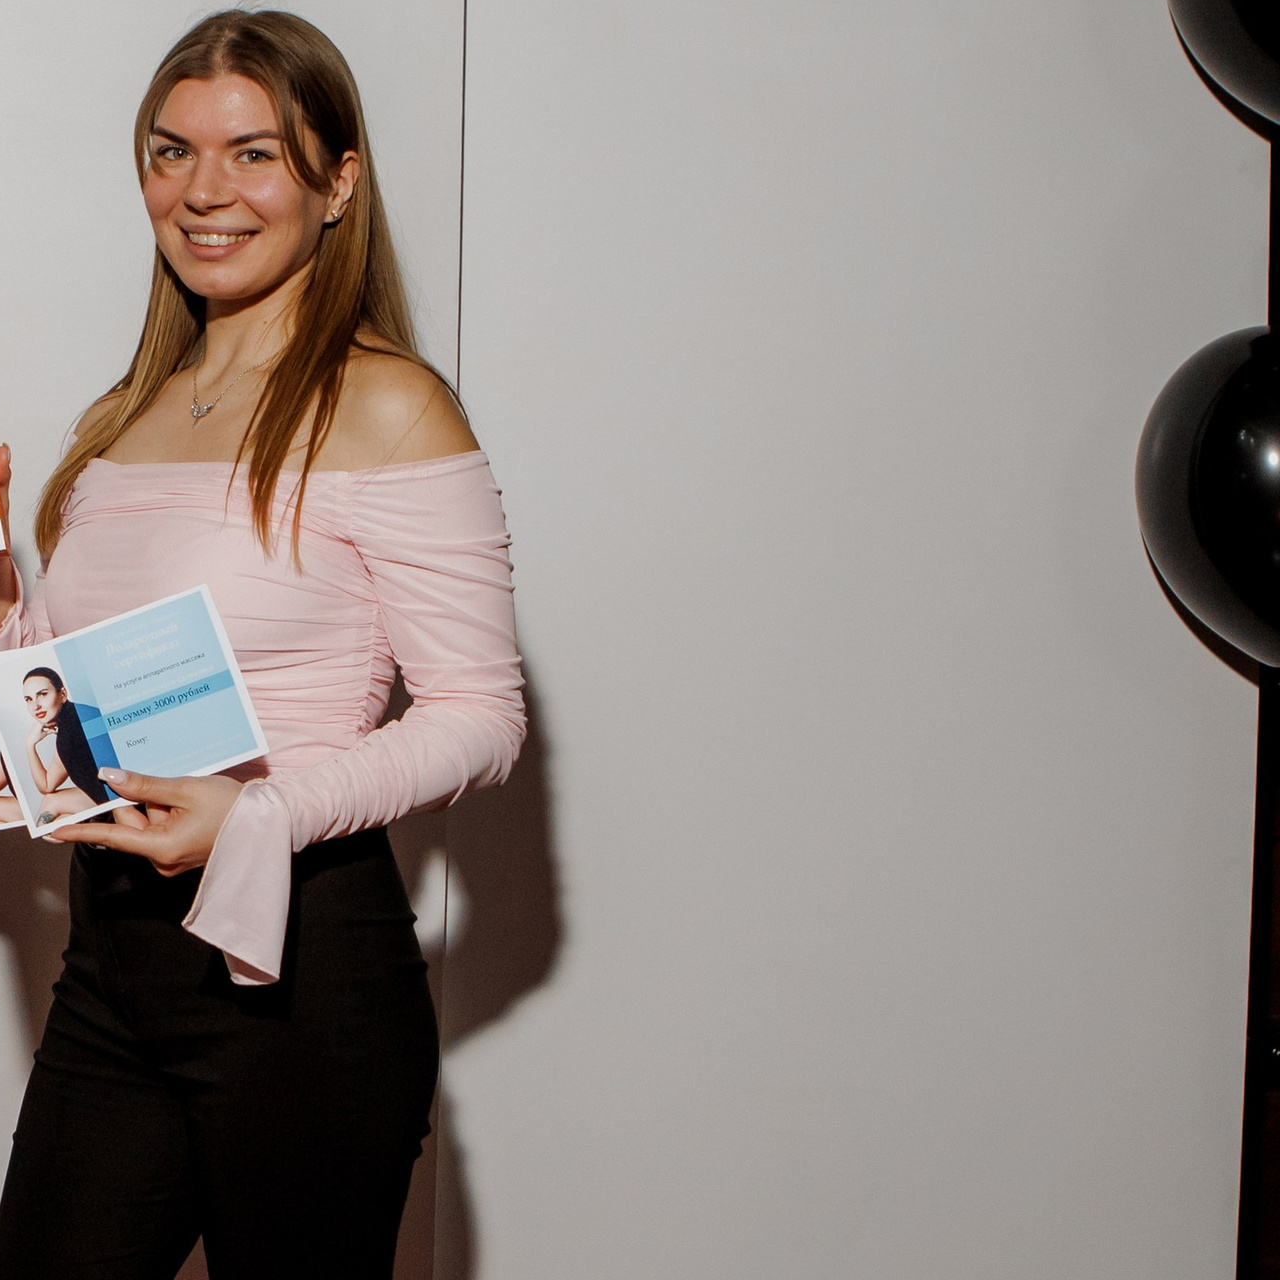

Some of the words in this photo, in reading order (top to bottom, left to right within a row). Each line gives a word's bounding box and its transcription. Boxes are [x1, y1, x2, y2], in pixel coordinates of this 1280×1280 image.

[113, 682, 123, 690] На
[123, 676, 142, 687] услуги
[143, 662, 180, 680] аппаратного
[180, 653, 205, 665] массажа
[107, 716, 121, 727] На
[122, 705, 152, 722] сумму
[154, 695, 176, 710] 3000
[177, 683, 210, 703] рублей
[126, 735, 149, 748] Кому:
